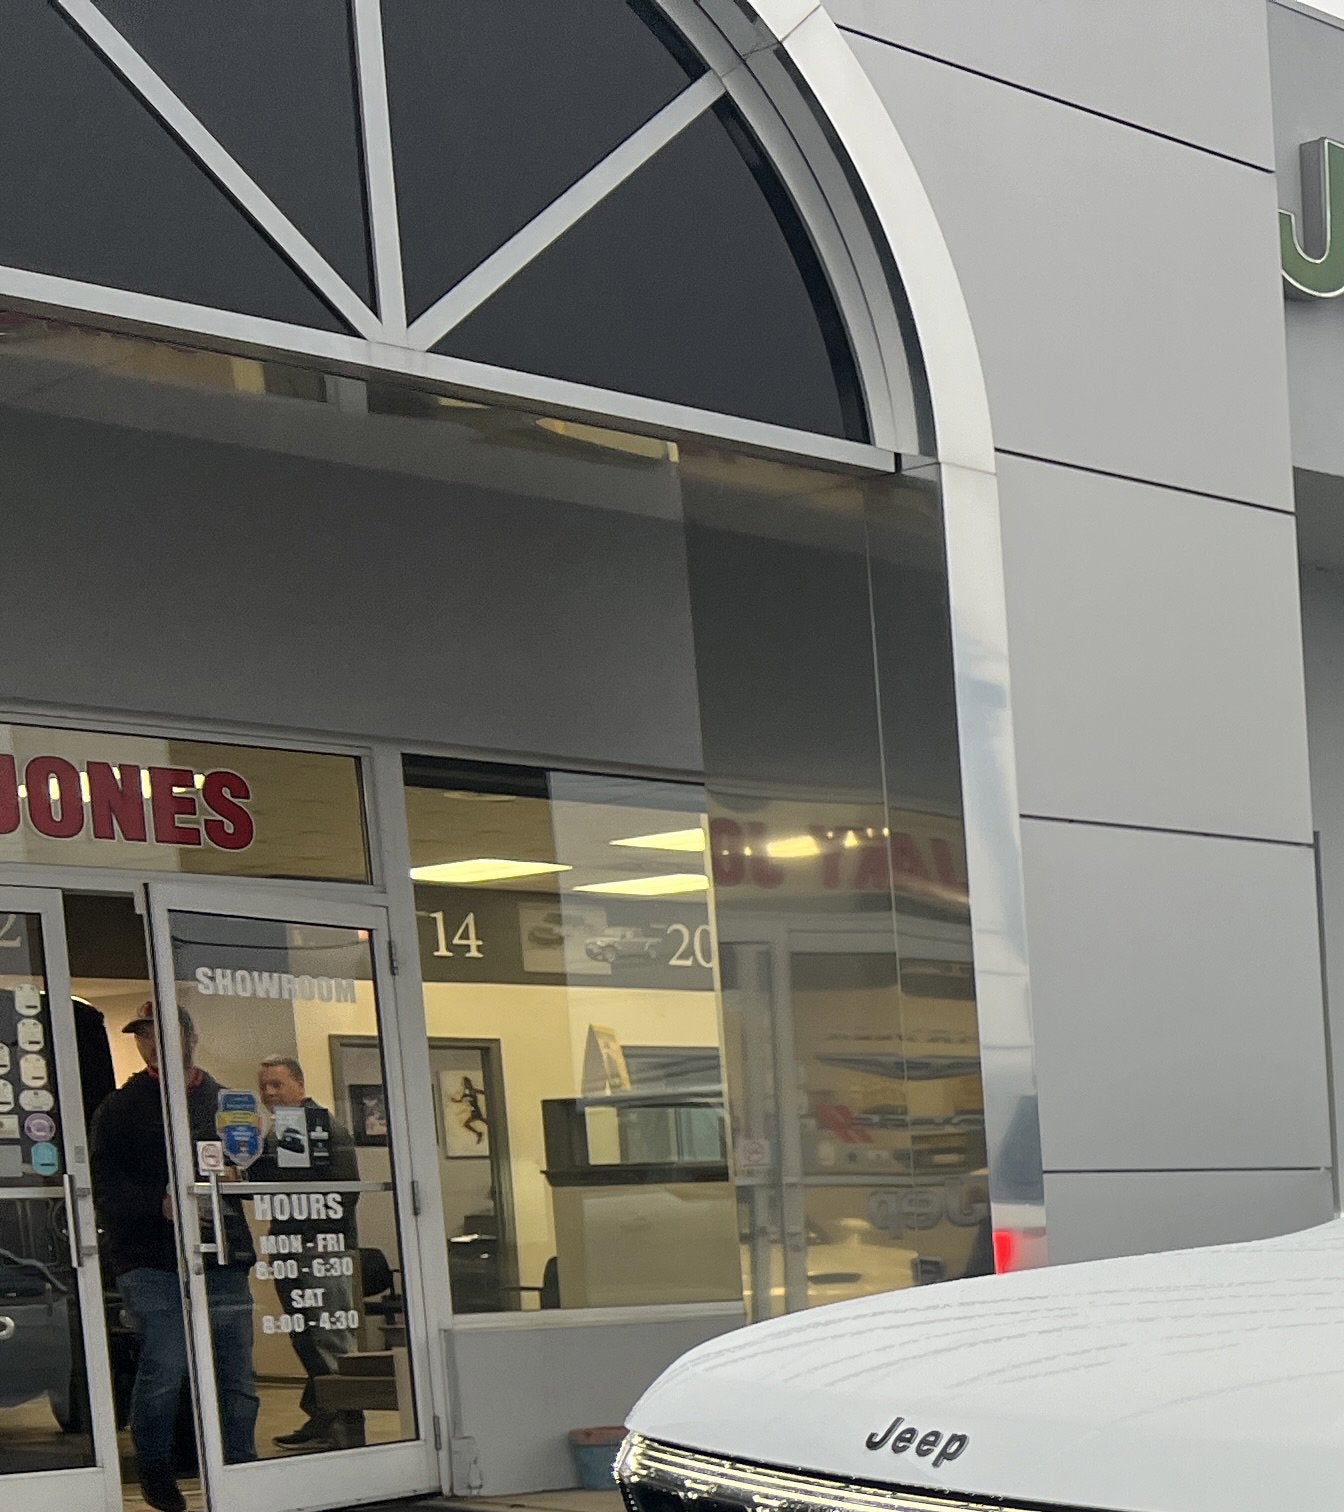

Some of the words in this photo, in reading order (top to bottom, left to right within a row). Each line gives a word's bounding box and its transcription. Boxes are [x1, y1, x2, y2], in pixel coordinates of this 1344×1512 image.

[429, 910, 484, 958] 14
[195, 966, 357, 1004] SHOWROOM
[253, 1193, 344, 1221] HOURS
[259, 1234, 303, 1254] MON
[316, 1232, 346, 1253] FRI
[290, 1288, 325, 1308] SAT
[319, 1310, 359, 1331] 4:30
[865, 1416, 970, 1468] Jeep
